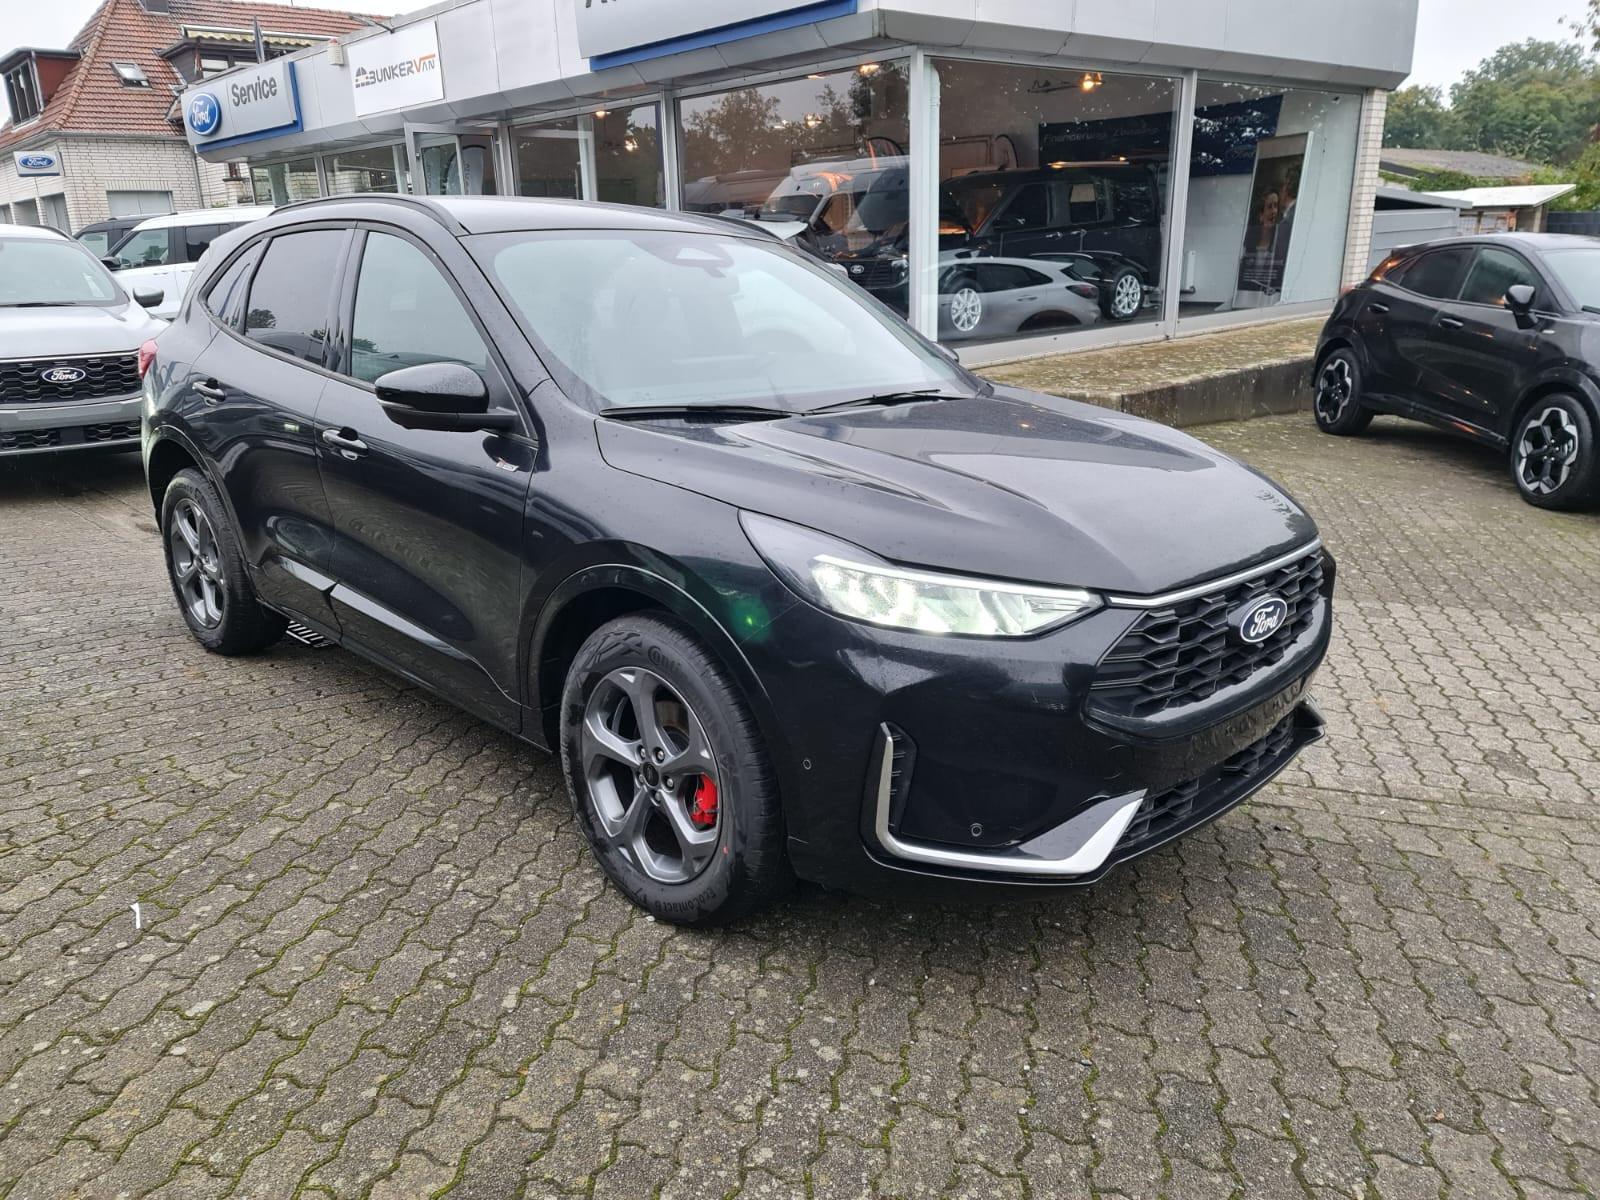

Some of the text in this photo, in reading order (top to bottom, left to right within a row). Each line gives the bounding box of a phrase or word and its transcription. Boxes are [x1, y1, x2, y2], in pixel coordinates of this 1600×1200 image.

[231, 75, 278, 108] Service
[51, 370, 78, 381] Ford
[1250, 605, 1281, 637] Ford
